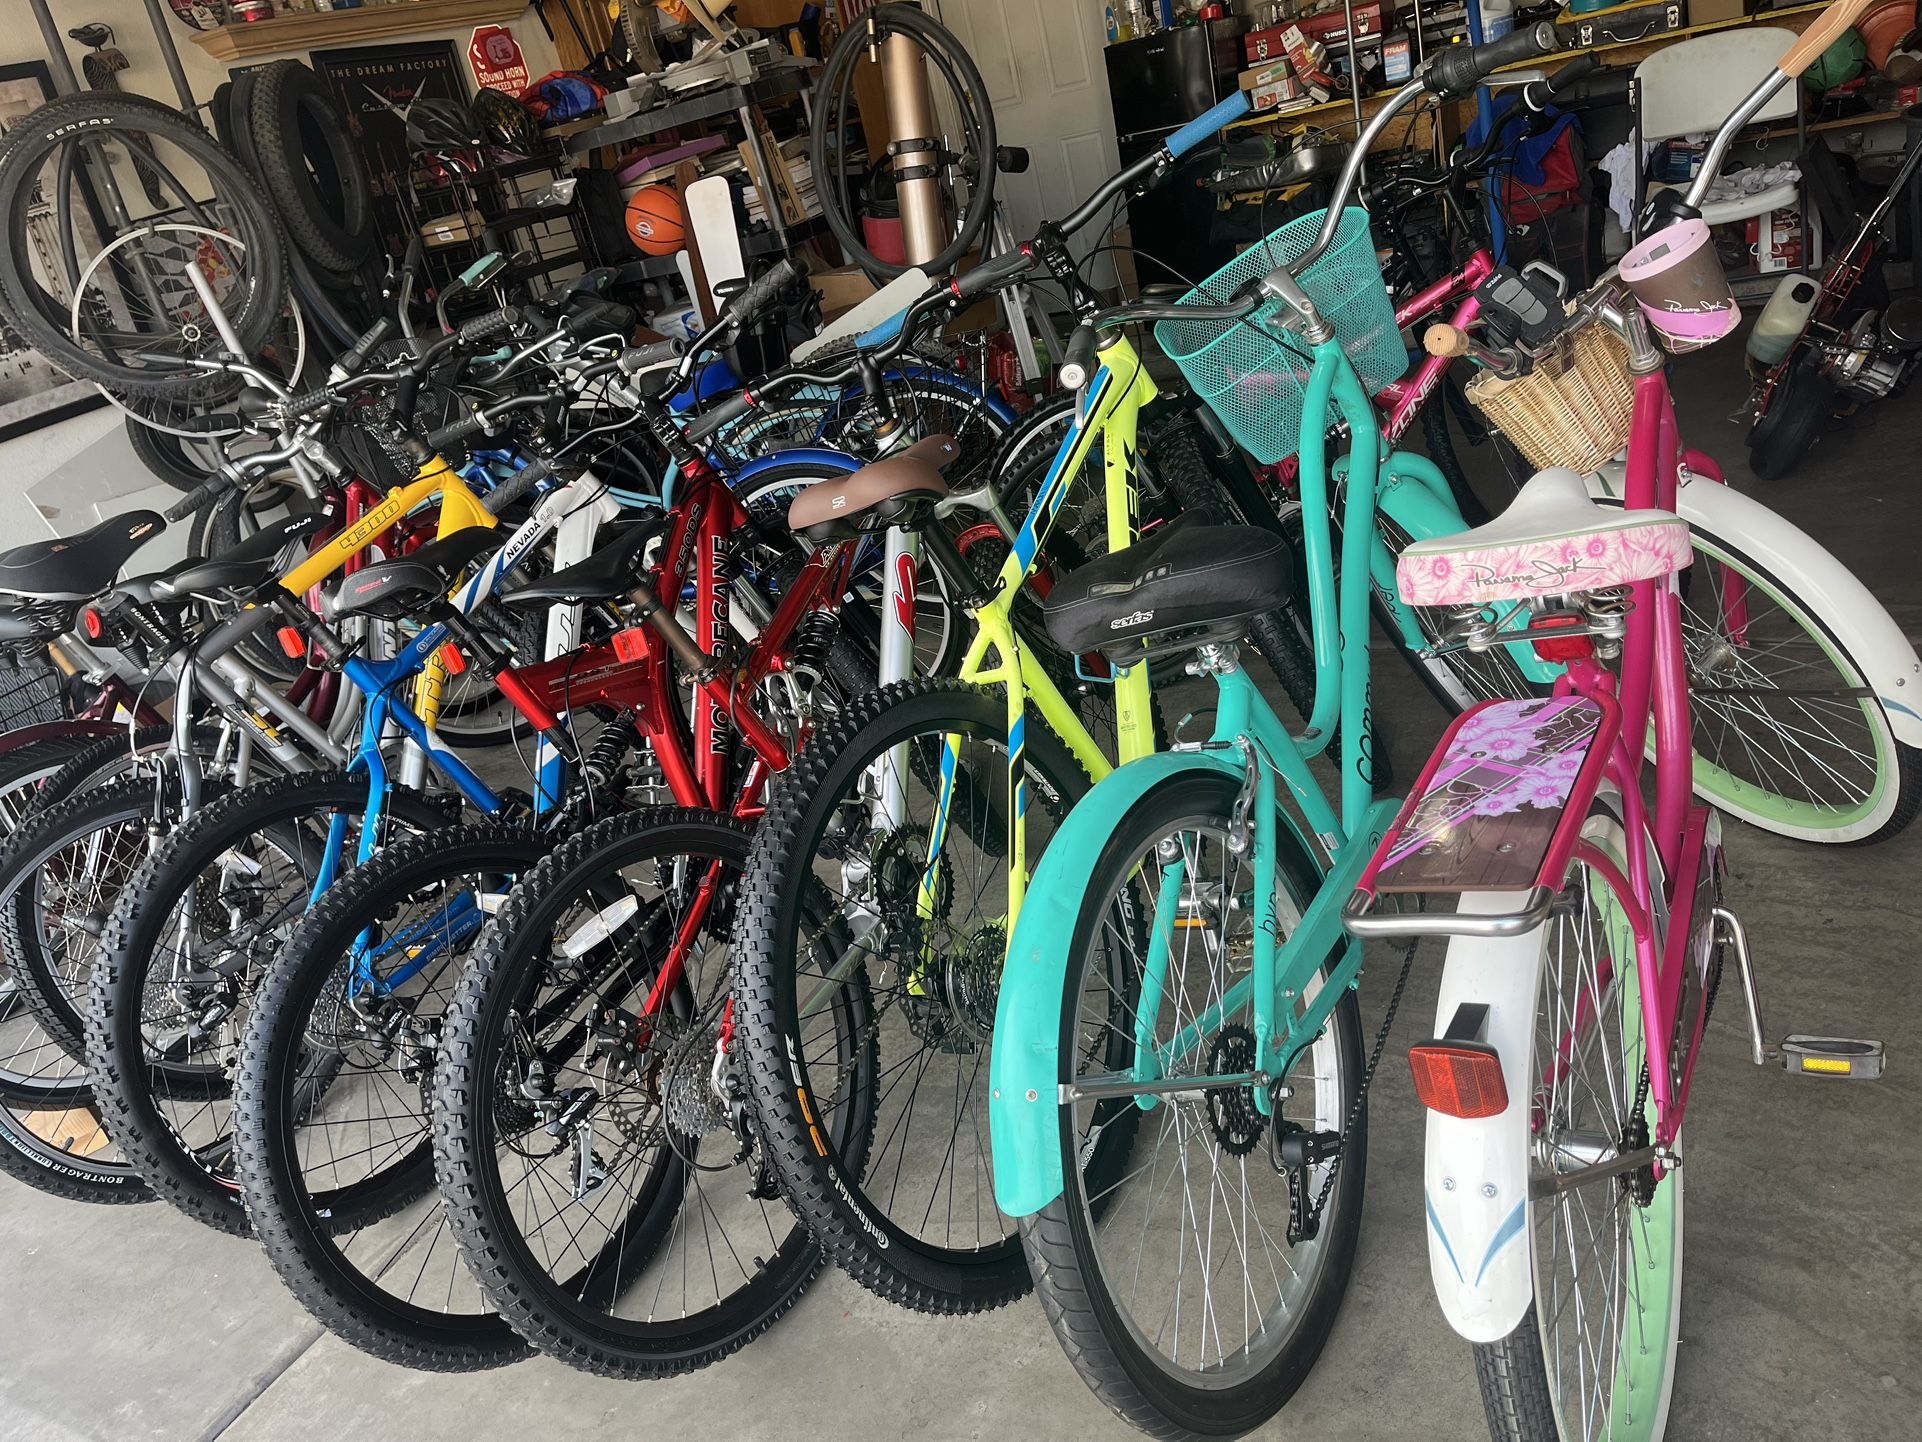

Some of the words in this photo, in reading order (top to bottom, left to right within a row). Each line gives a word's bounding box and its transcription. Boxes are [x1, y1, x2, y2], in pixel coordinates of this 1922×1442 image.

[1330, 29, 1348, 38] HUSK
[1384, 44, 1407, 55] FRAM
[330, 68, 351, 78] THE
[356, 64, 395, 76] DREAM
[400, 58, 449, 72] FACTORY
[479, 70, 505, 84] SOUND
[504, 65, 526, 79] HORN
[45, 117, 112, 141] SERFAS
[283, 516, 312, 534] FUJI
[339, 500, 401, 549] 4300
[506, 522, 541, 560] NEVADA
[674, 502, 701, 578] 350DS
[1525, 557, 1608, 589] Jack
[130, 607, 171, 645] BONTRAGER
[1110, 610, 1154, 630] serfas
[52, 1164, 125, 1187] BONTRAGER
[834, 1176, 890, 1250] Continental
